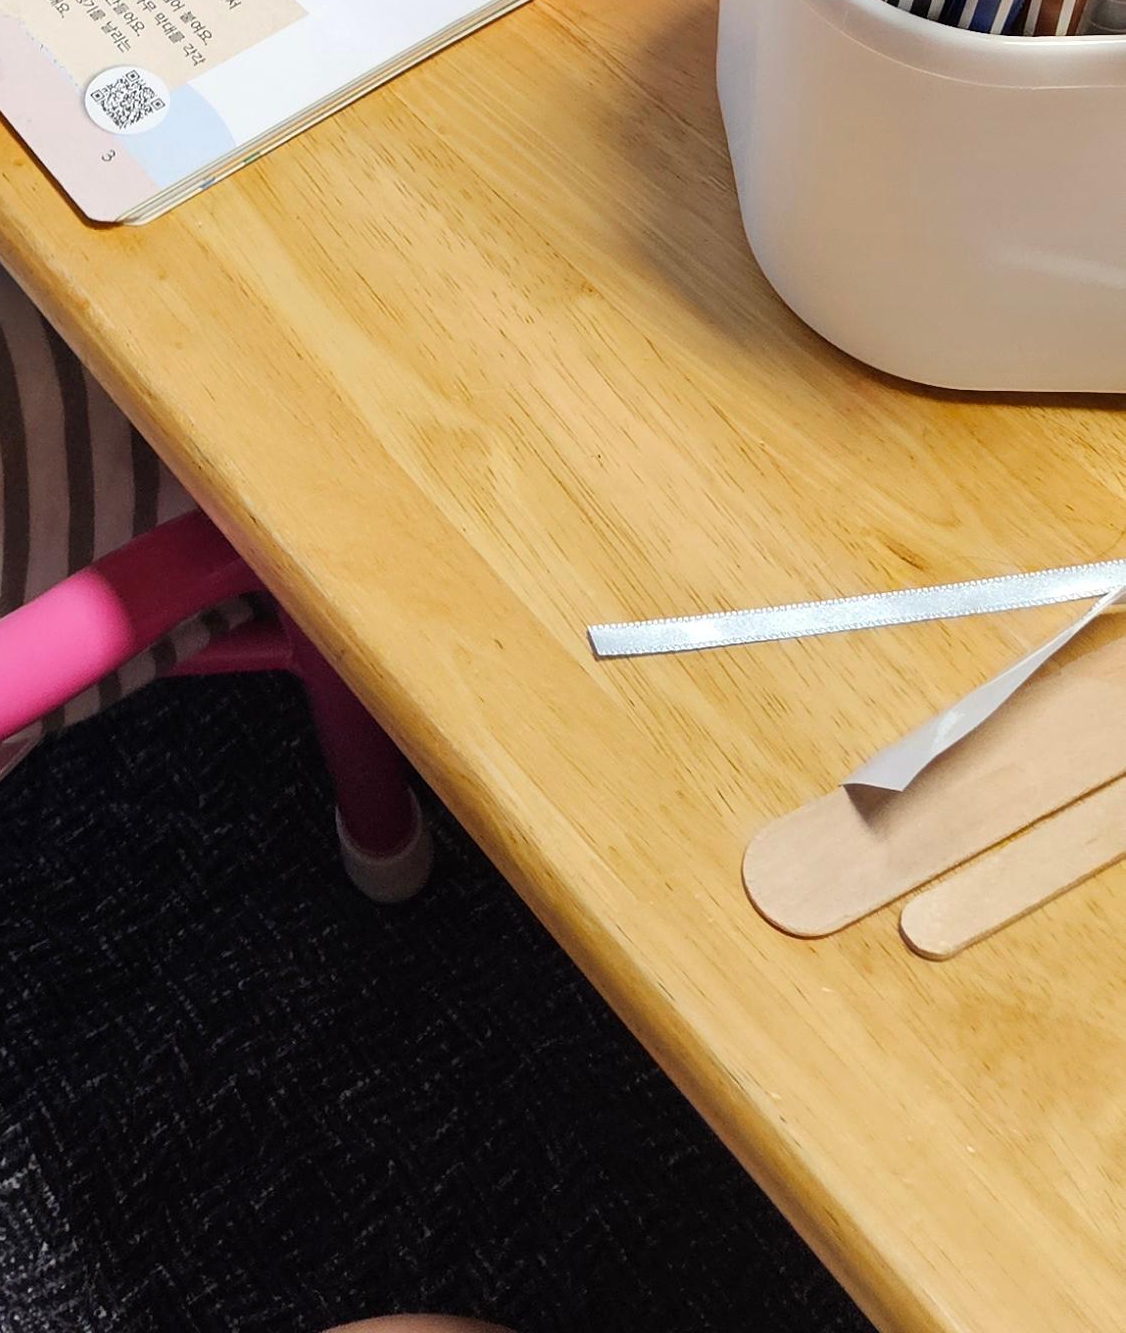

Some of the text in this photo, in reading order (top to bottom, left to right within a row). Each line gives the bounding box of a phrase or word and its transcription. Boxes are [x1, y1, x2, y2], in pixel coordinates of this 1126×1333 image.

[101, 20, 132, 54] 날리는
[154, 12, 185, 44] 막대를
[183, 43, 206, 67] 각각
[180, 11, 212, 45] 붙여요.
[101, 149, 116, 163] 3
